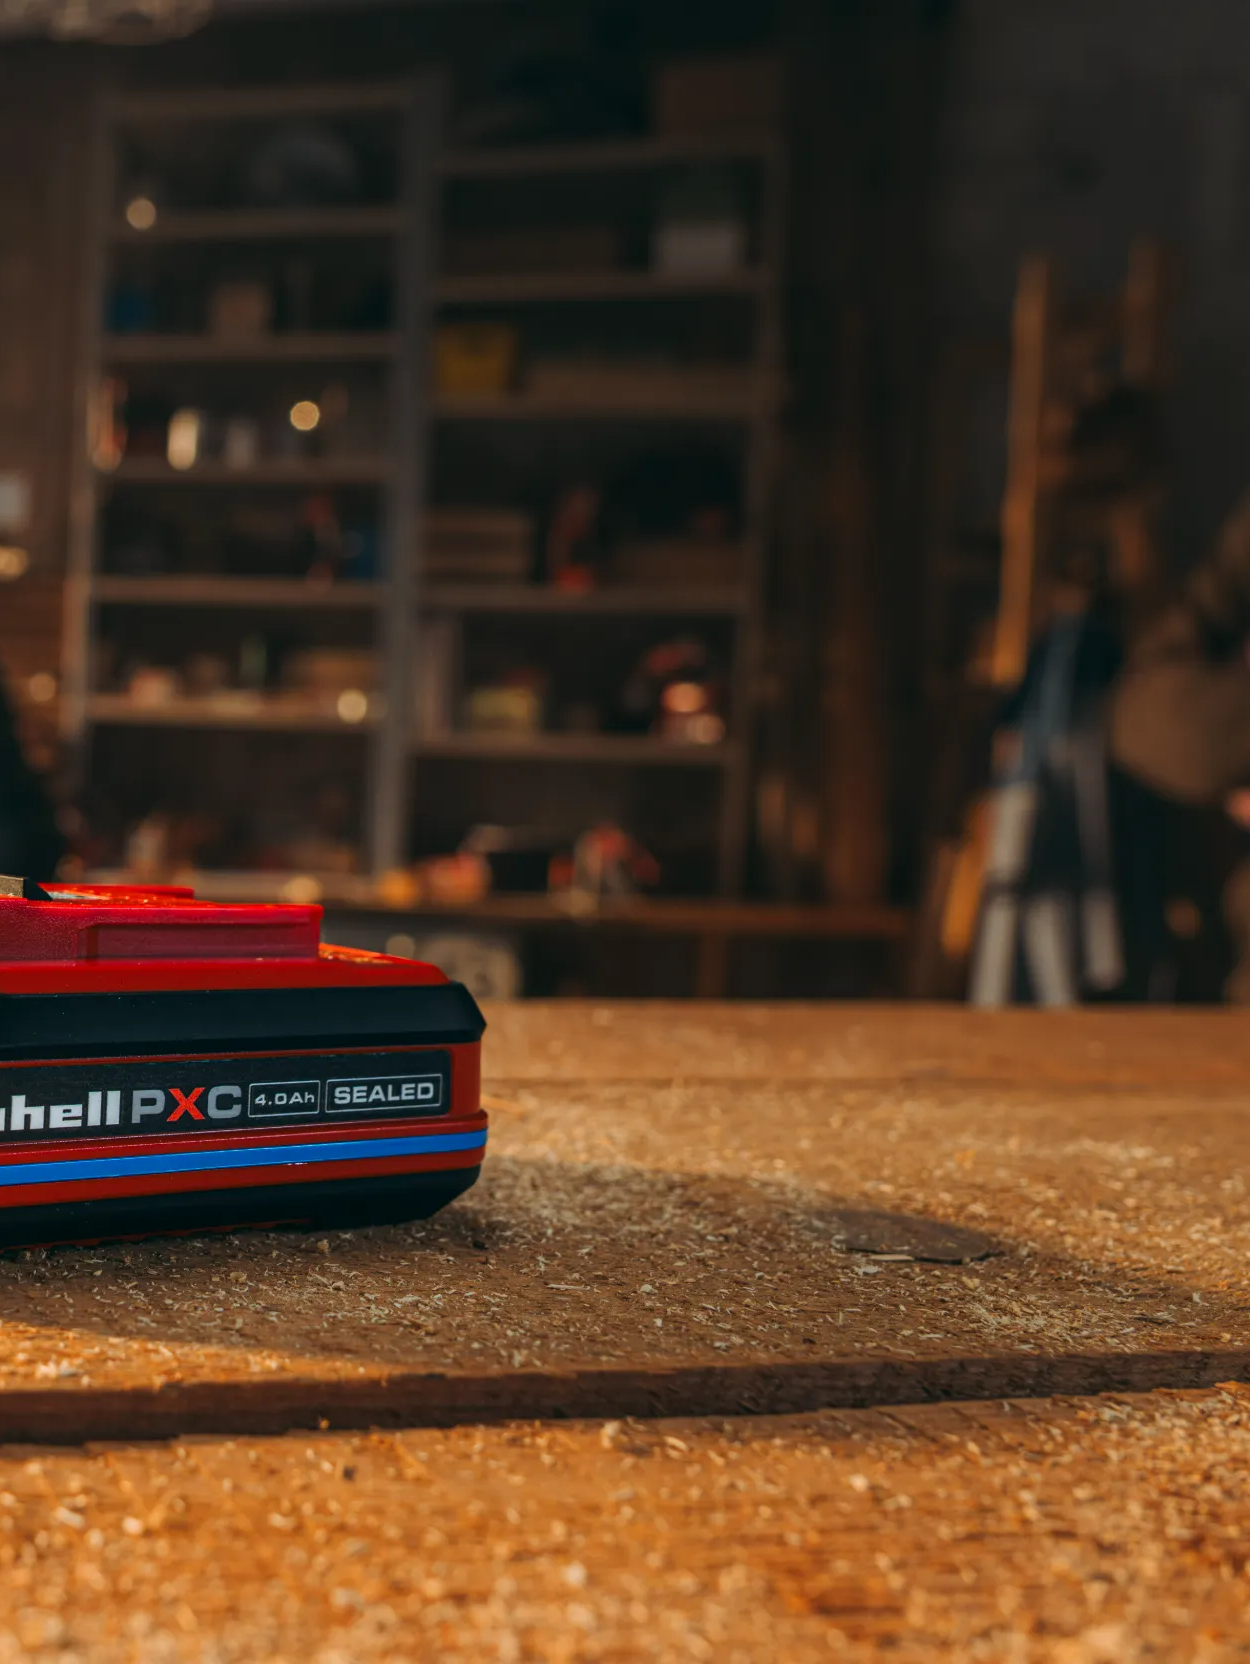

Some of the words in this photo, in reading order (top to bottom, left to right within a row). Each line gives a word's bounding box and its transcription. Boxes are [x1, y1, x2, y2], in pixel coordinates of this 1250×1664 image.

[131, 1085, 242, 1124] PXC
[254, 1091, 315, 1107] 4.0Ah
[333, 1082, 434, 1106] SEALED
